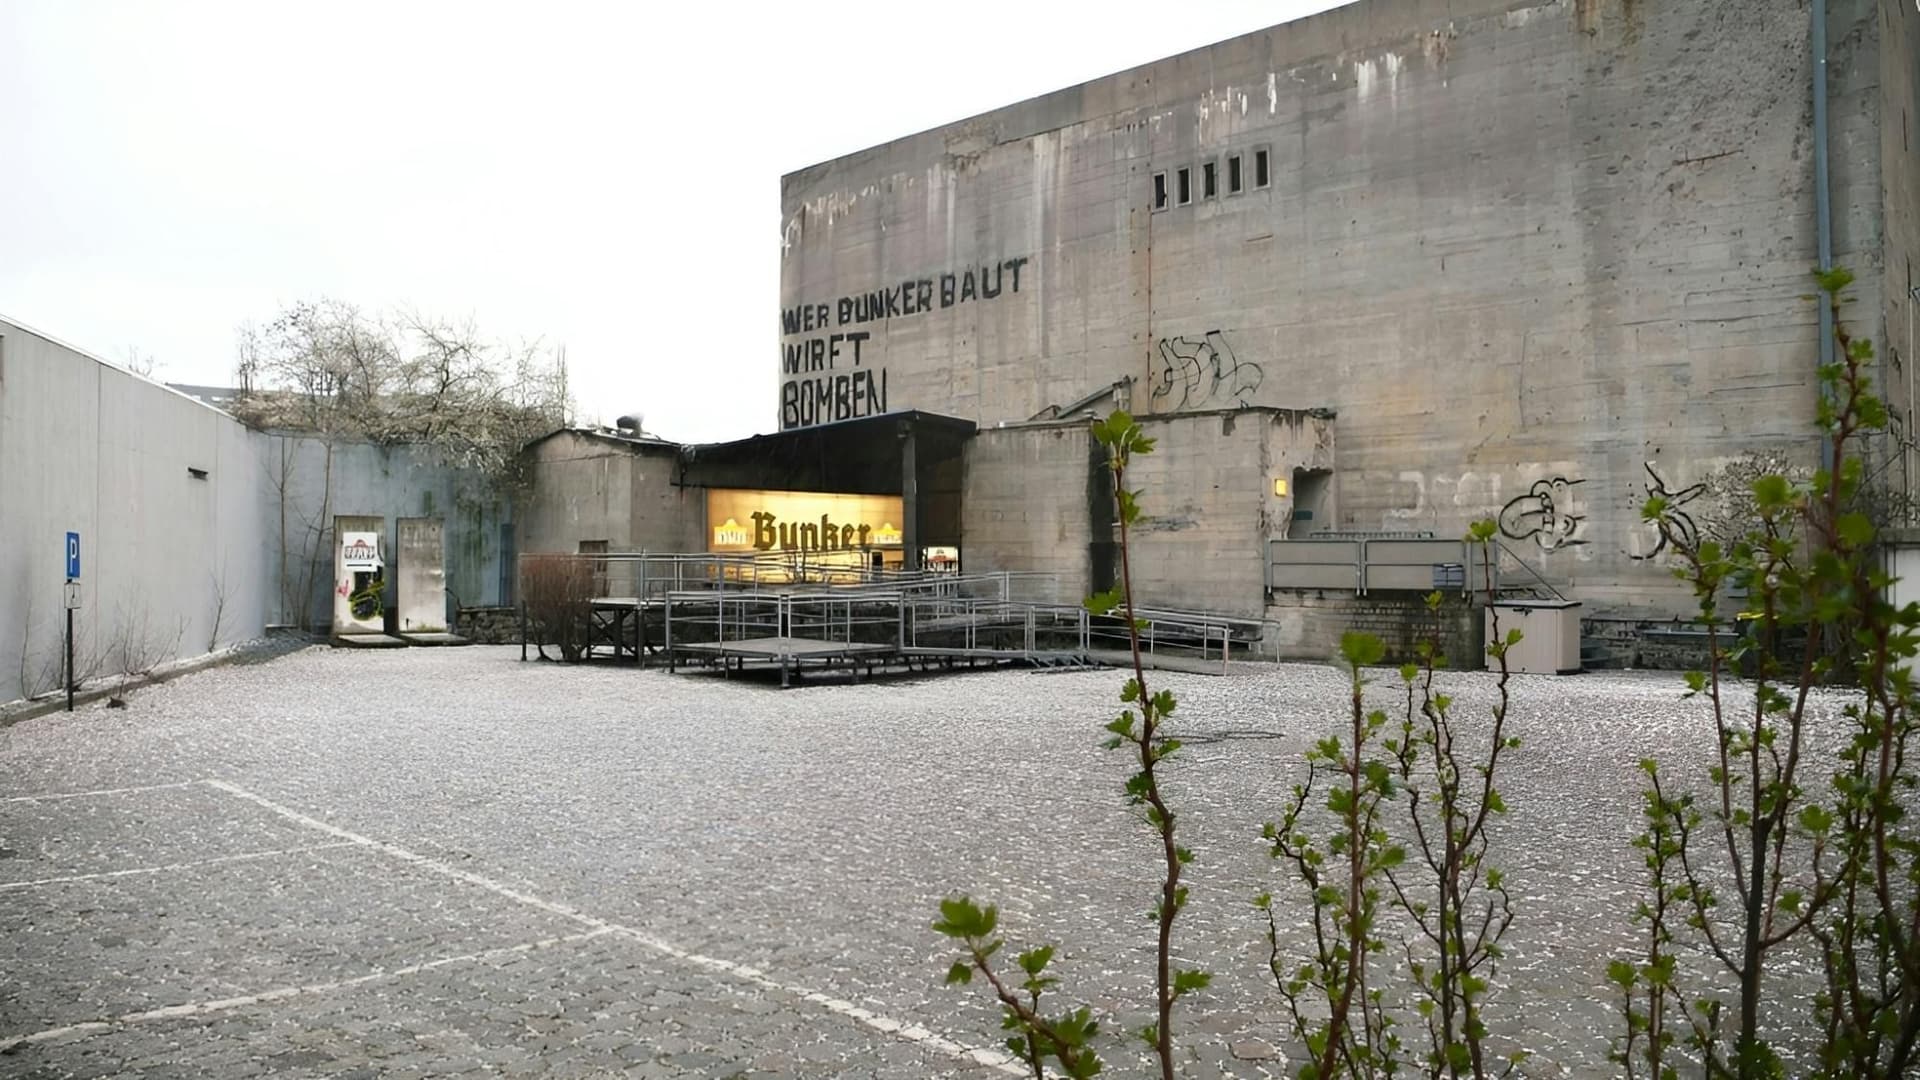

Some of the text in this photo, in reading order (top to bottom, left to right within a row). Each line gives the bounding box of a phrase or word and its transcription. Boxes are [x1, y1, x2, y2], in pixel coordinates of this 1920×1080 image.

[782, 257, 1028, 335] WER BUNKER BAUT
[782, 332, 870, 374] WIRFT
[782, 367, 887, 428] BOMBEN
[751, 511, 871, 551] Bunker
[70, 538, 77, 573] P
